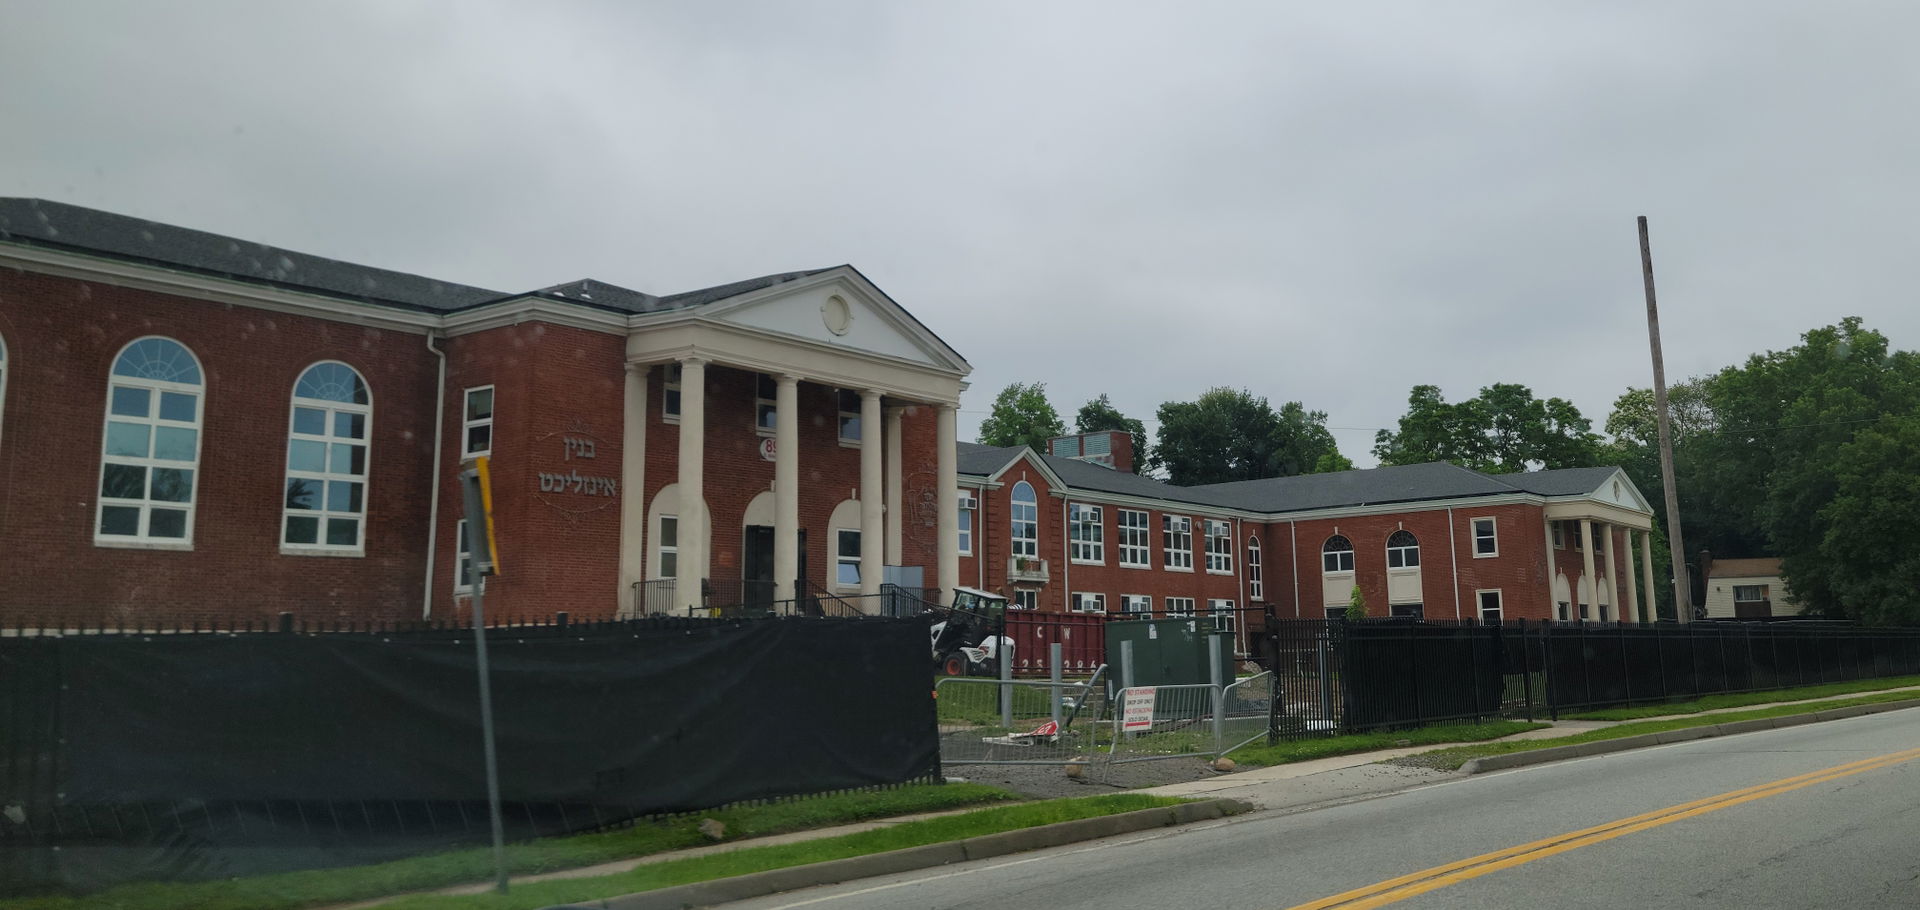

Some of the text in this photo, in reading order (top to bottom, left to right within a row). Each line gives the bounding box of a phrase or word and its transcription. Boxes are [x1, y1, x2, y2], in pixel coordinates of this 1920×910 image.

[563, 436, 596, 461] בנין
[1037, 626, 1071, 640] C W
